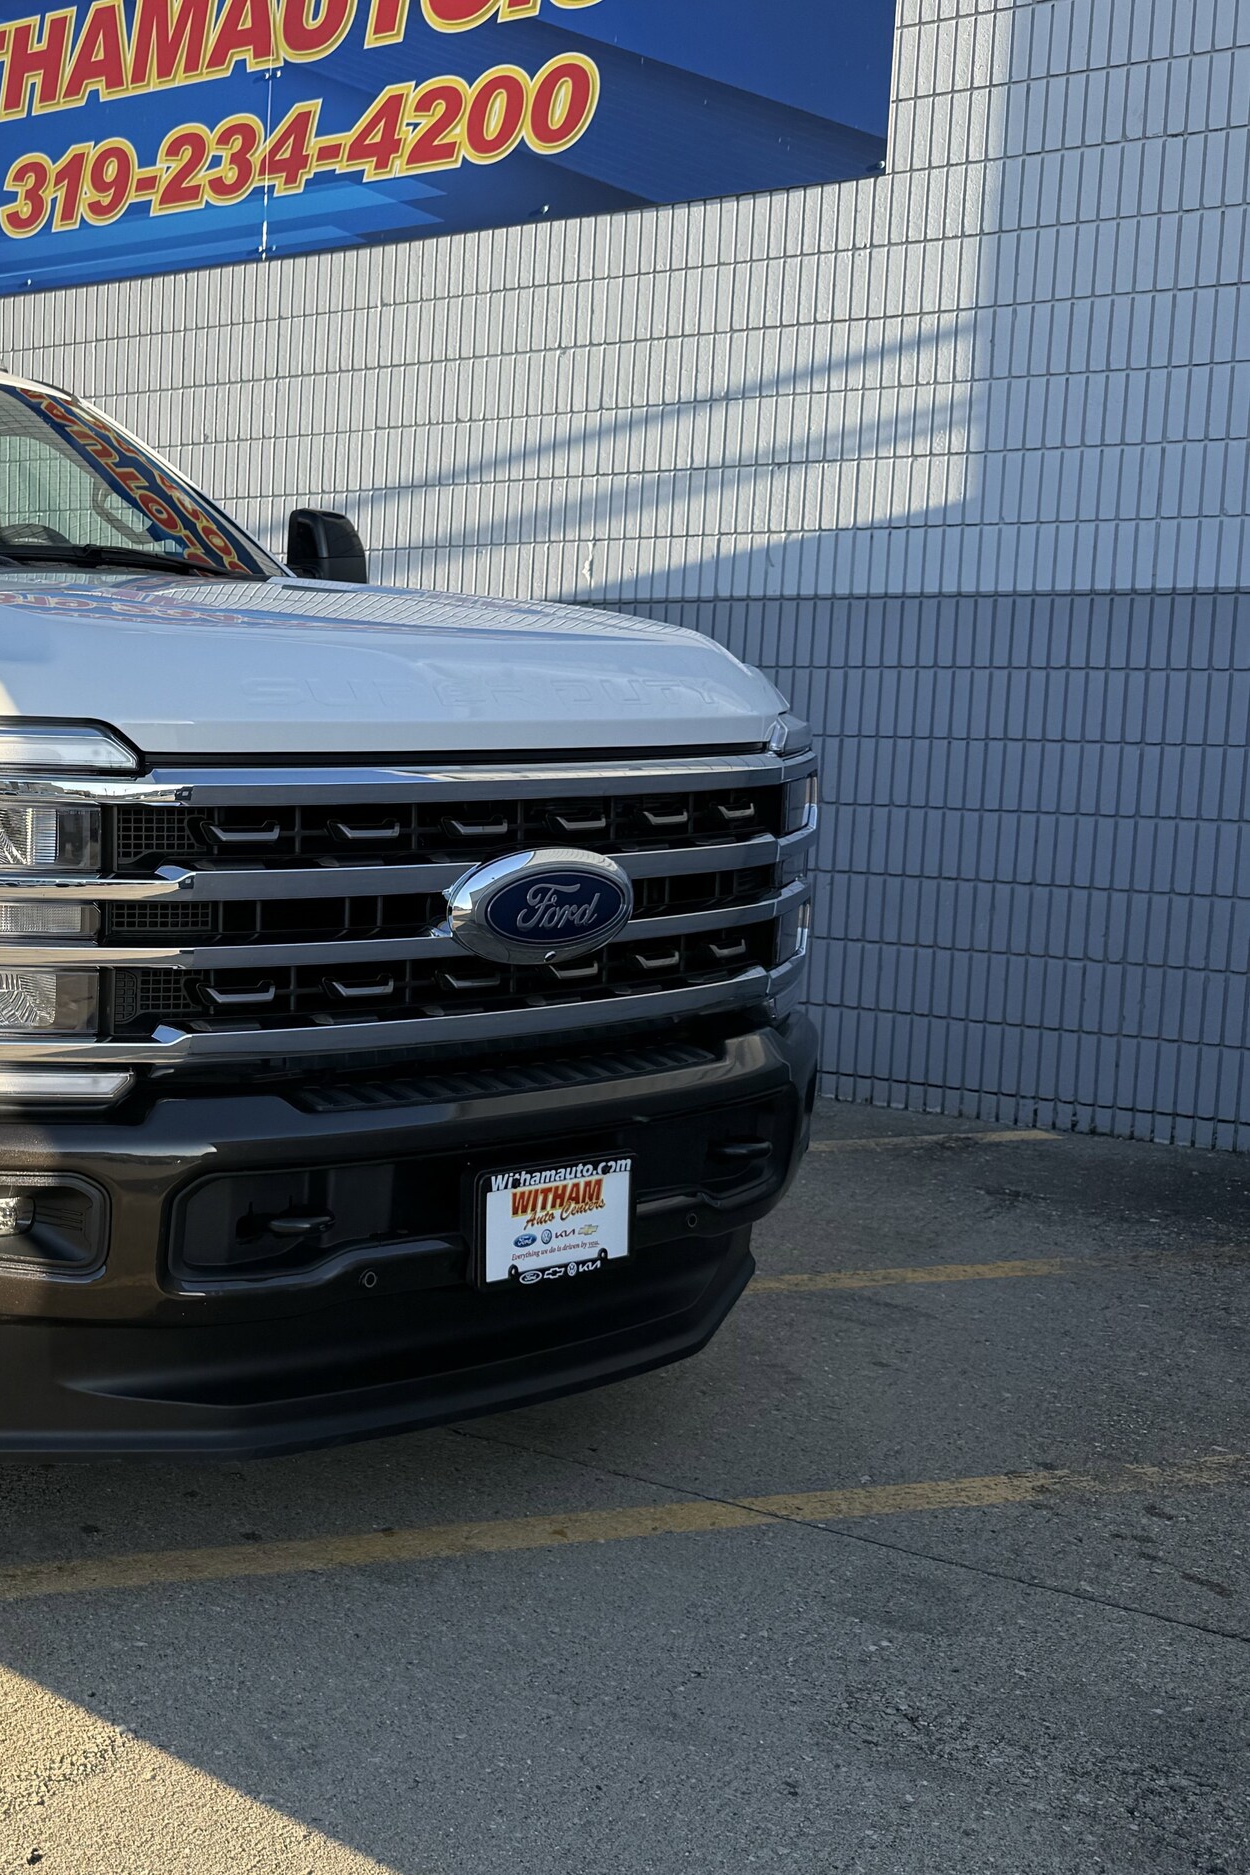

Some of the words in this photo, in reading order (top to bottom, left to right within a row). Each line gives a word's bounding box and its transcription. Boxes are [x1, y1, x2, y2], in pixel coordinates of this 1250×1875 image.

[0, 52, 602, 240] 319-234-4200
[516, 882, 602, 933] Ford
[511, 1178, 605, 1219] WITHAM
[523, 1209, 556, 1230] Auto
[559, 1198, 606, 1221] Centers
